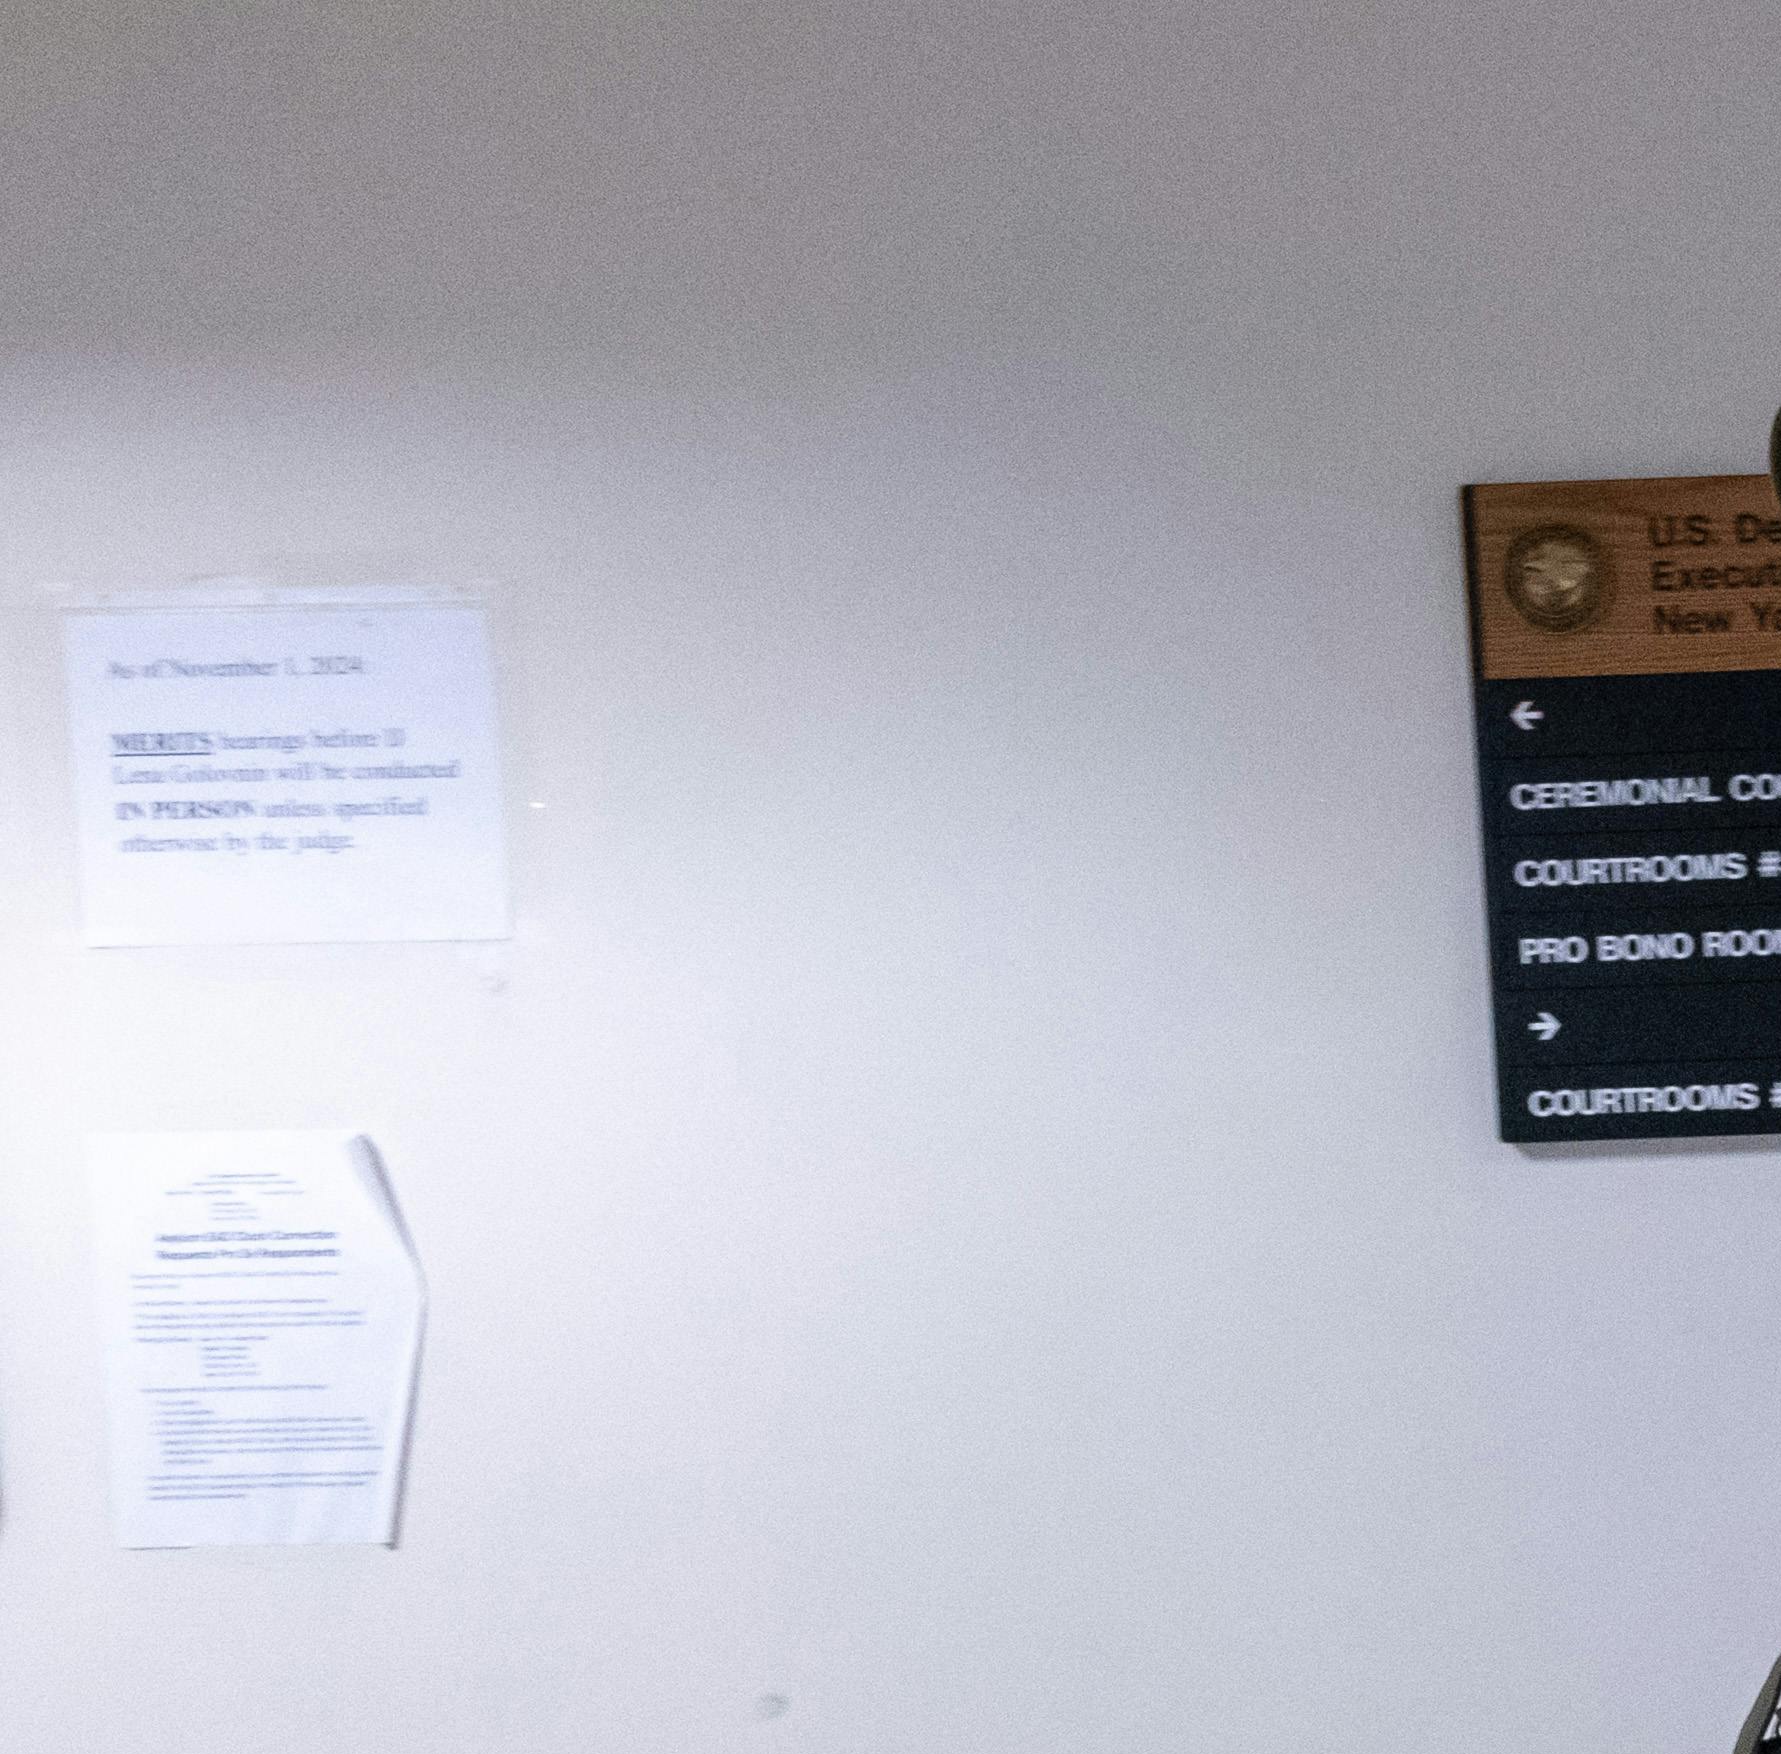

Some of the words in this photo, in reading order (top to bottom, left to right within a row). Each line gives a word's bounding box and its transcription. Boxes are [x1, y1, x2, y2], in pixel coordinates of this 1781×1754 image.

[1653, 604, 1733, 635] New
[1509, 775, 1722, 811] CEREMONIAL
[1514, 851, 1748, 888] COURTROOMS
[1518, 936, 1589, 965] PRO
[1596, 932, 1694, 962] BONO
[1528, 1081, 1760, 1117] COURTROOMS
